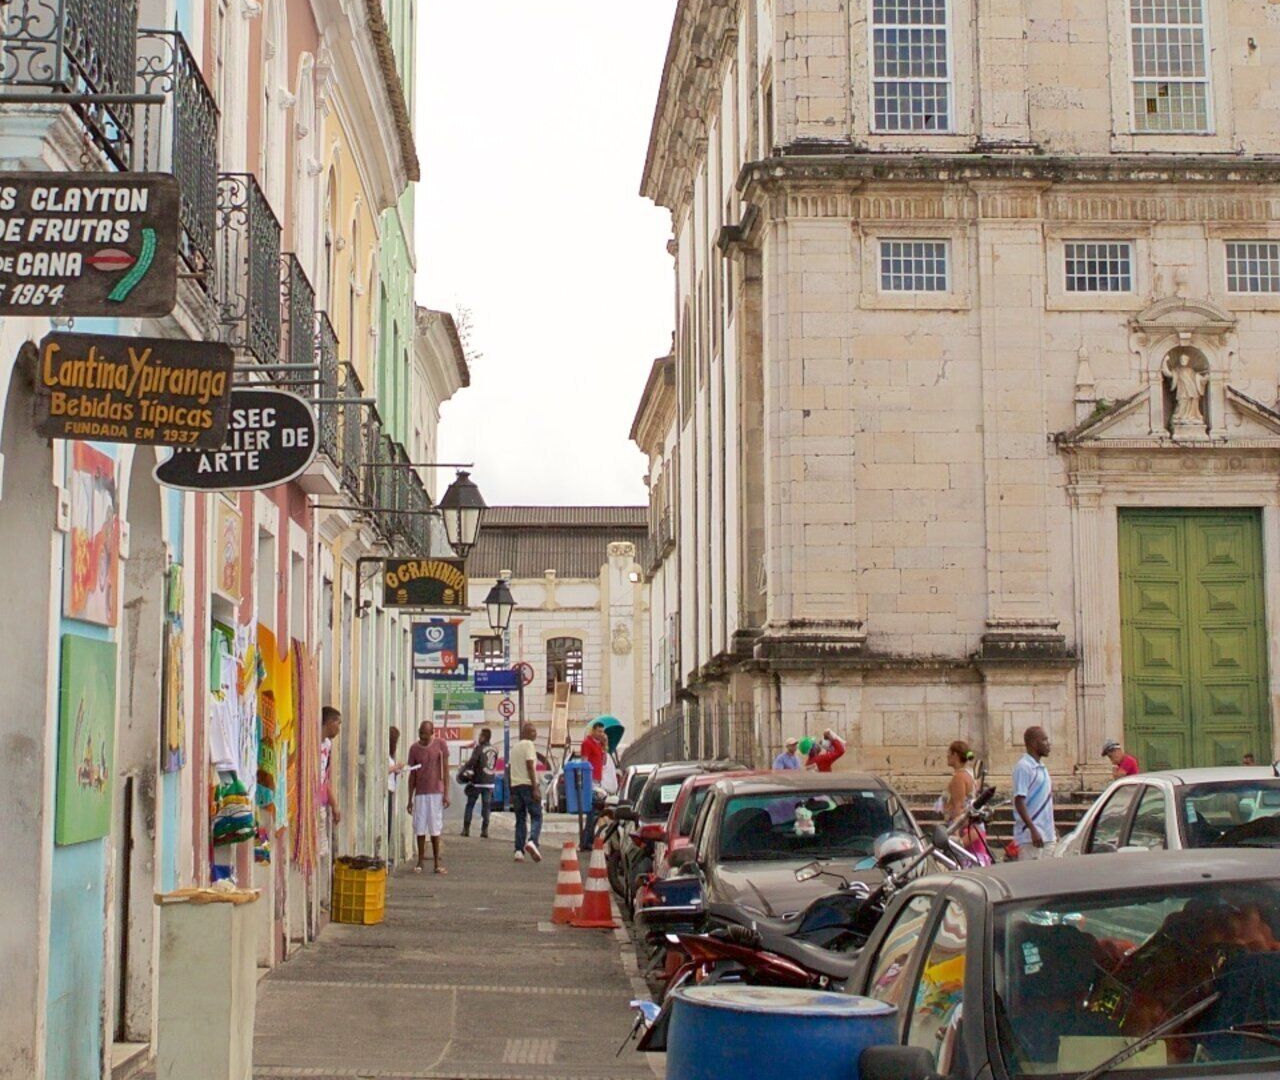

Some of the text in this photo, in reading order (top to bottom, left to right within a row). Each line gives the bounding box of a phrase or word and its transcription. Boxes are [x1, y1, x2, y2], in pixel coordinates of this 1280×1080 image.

[31, 187, 148, 212] CLAYTON
[27, 219, 130, 243] FRUTAS
[16, 252, 82, 277] CANA
[9, 284, 65, 306] 1964
[43, 342, 227, 405] Cantina Ypiranga
[51, 391, 214, 430] Bebidas Típicas
[228, 408, 276, 430] SEC
[65, 420, 200, 444] FUNDADA EM 1937
[281, 427, 309, 448] DE
[197, 451, 260, 473] ARTE
[386, 572, 399, 589] O
